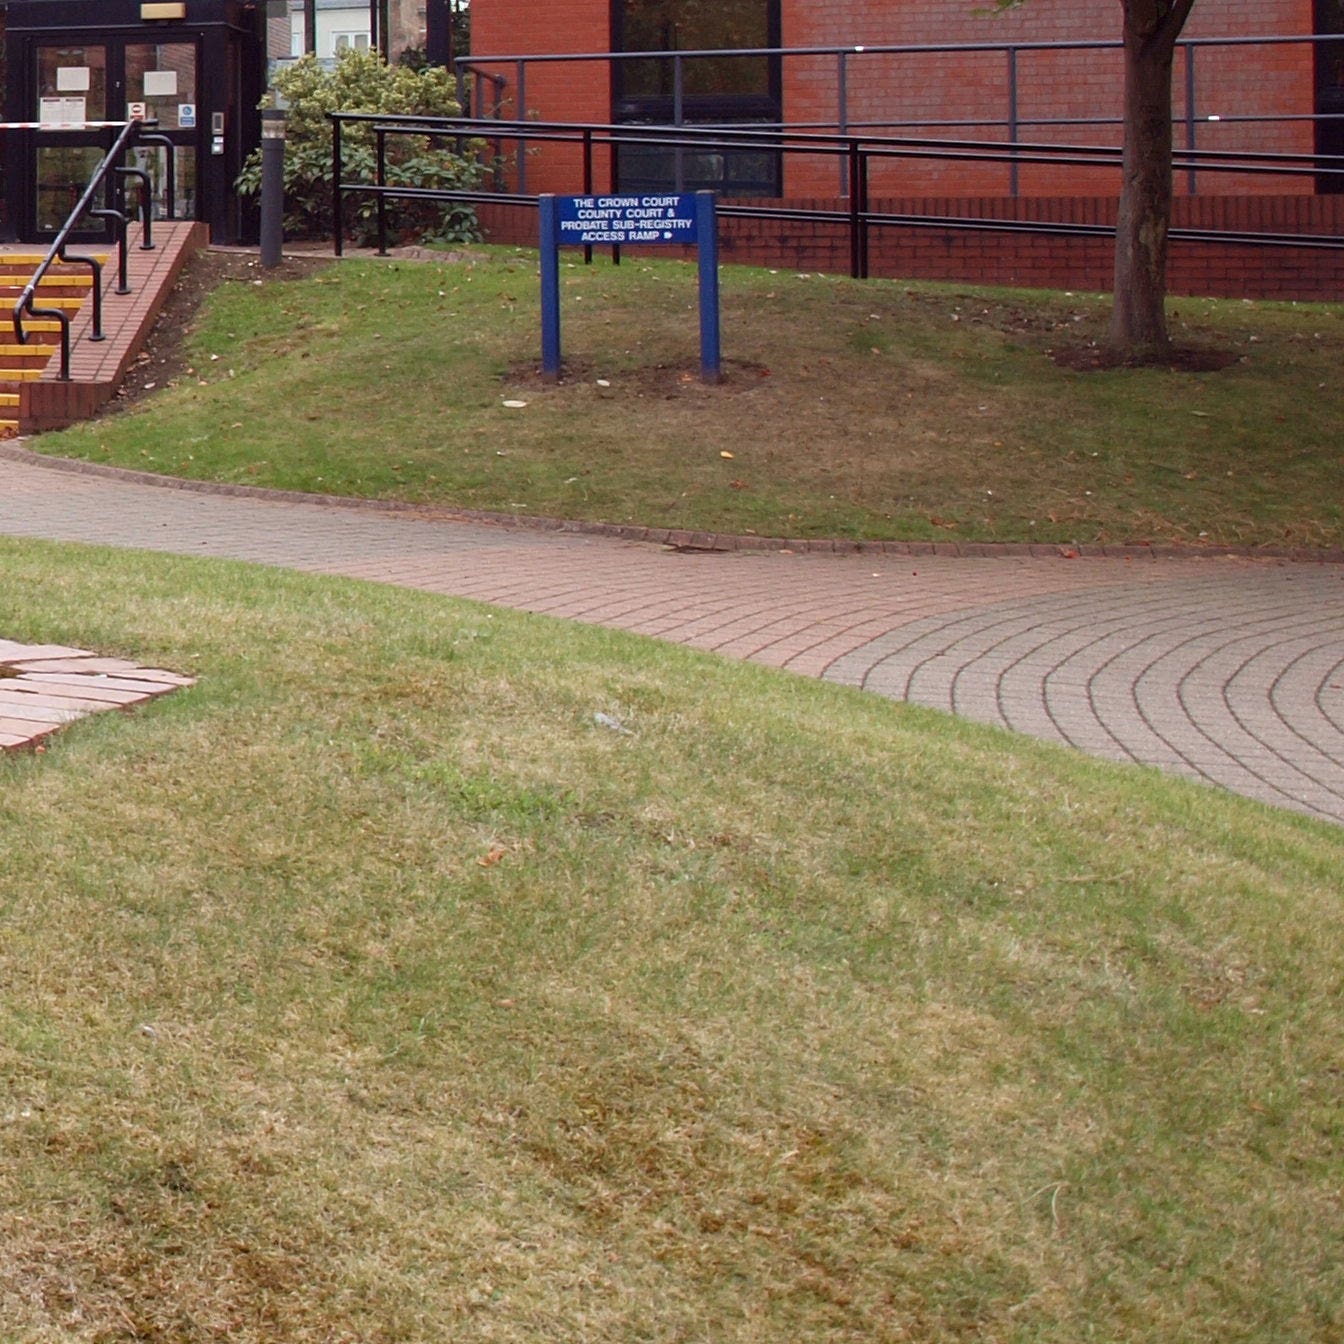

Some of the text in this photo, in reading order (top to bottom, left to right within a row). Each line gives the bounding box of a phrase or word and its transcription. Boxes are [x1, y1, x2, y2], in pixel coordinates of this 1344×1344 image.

[573, 196, 680, 208] THE CROWN COURT
[578, 208, 675, 219] COUNTY COURT &
[561, 219, 693, 231] PROBATE SUB-REGISTRY
[581, 231, 660, 241] ACCESS RAMP
